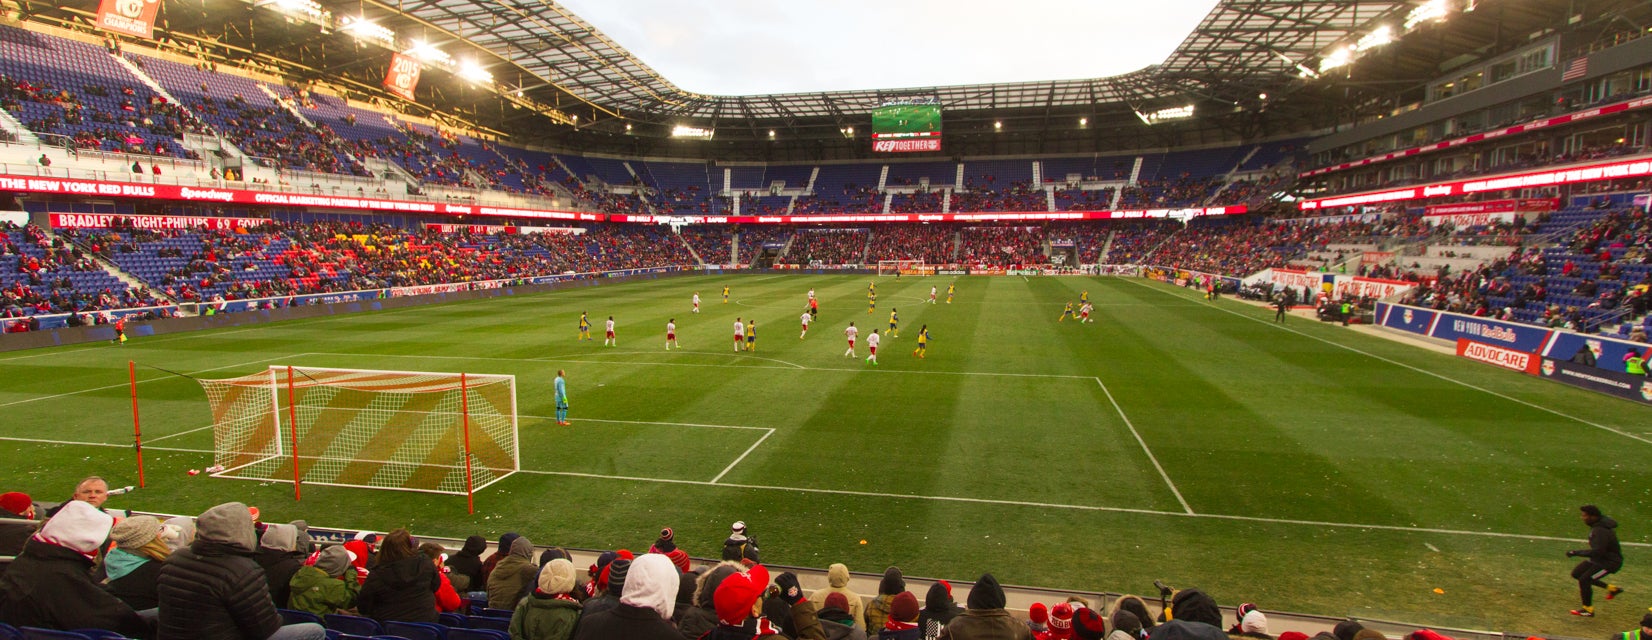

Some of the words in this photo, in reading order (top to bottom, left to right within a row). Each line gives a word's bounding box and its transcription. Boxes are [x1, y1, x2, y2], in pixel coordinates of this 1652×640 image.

[103, 17, 147, 34] CHAMPIONS
[393, 57, 418, 77] 2015
[0, 179, 26, 190] THE
[29, 179, 60, 191] NEW
[62, 181, 97, 193] YORK
[98, 184, 121, 194] RED
[123, 185, 155, 196] BULLS
[255, 194, 289, 203] OFFICIAL
[289, 196, 331, 206] MARKETING
[59, 214, 114, 227] BRADLEY
[118, 216, 209, 229] RIGHT-PHILLIPS
[1453, 320, 1465, 332] NEW
[1466, 321, 1481, 335] YORK
[1464, 342, 1529, 371] ADVOCARE
[1052, 619, 1064, 628] RED
